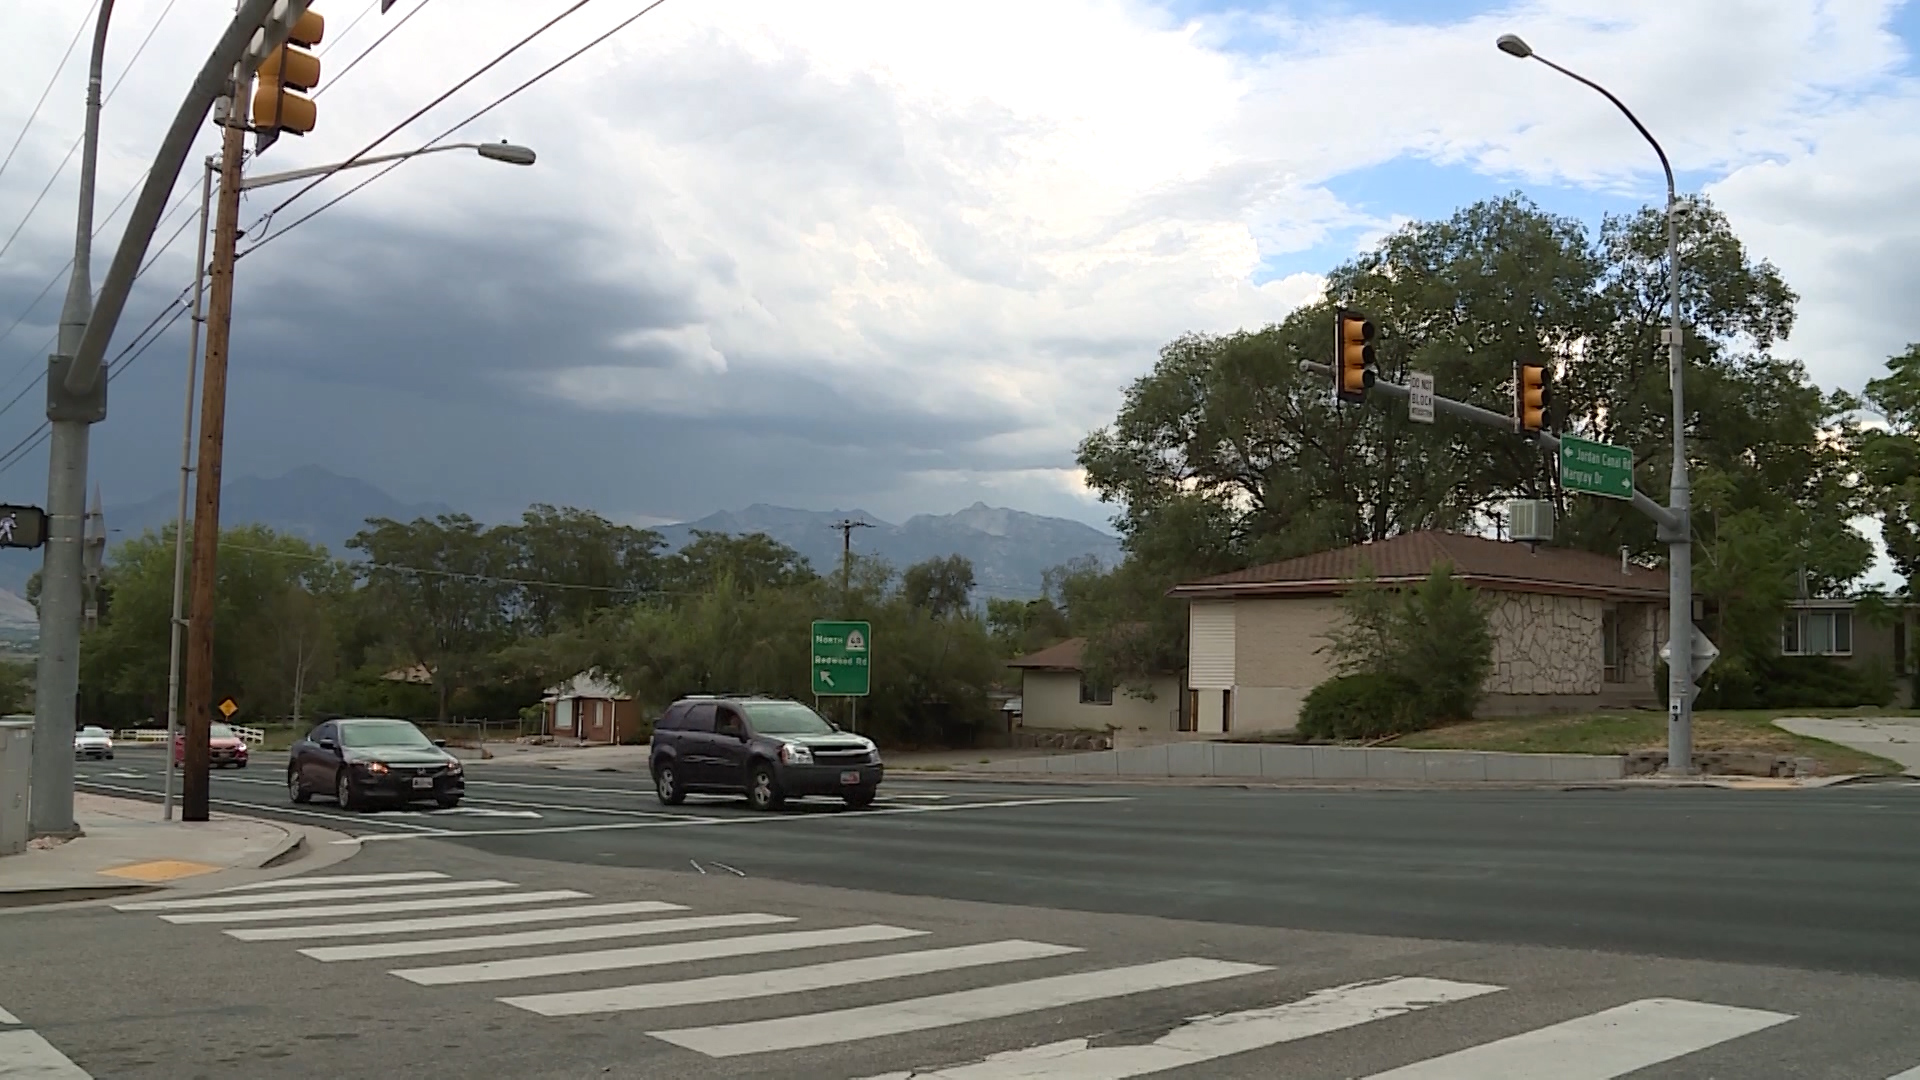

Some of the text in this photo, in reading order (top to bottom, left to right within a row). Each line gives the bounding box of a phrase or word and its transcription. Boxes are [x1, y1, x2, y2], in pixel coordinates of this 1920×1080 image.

[1412, 393, 1432, 406] BLOCK
[1576, 447, 1631, 470] Jordan Canal Rd
[1594, 471, 1603, 485] Dr
[814, 655, 868, 666] Redwood Rd
